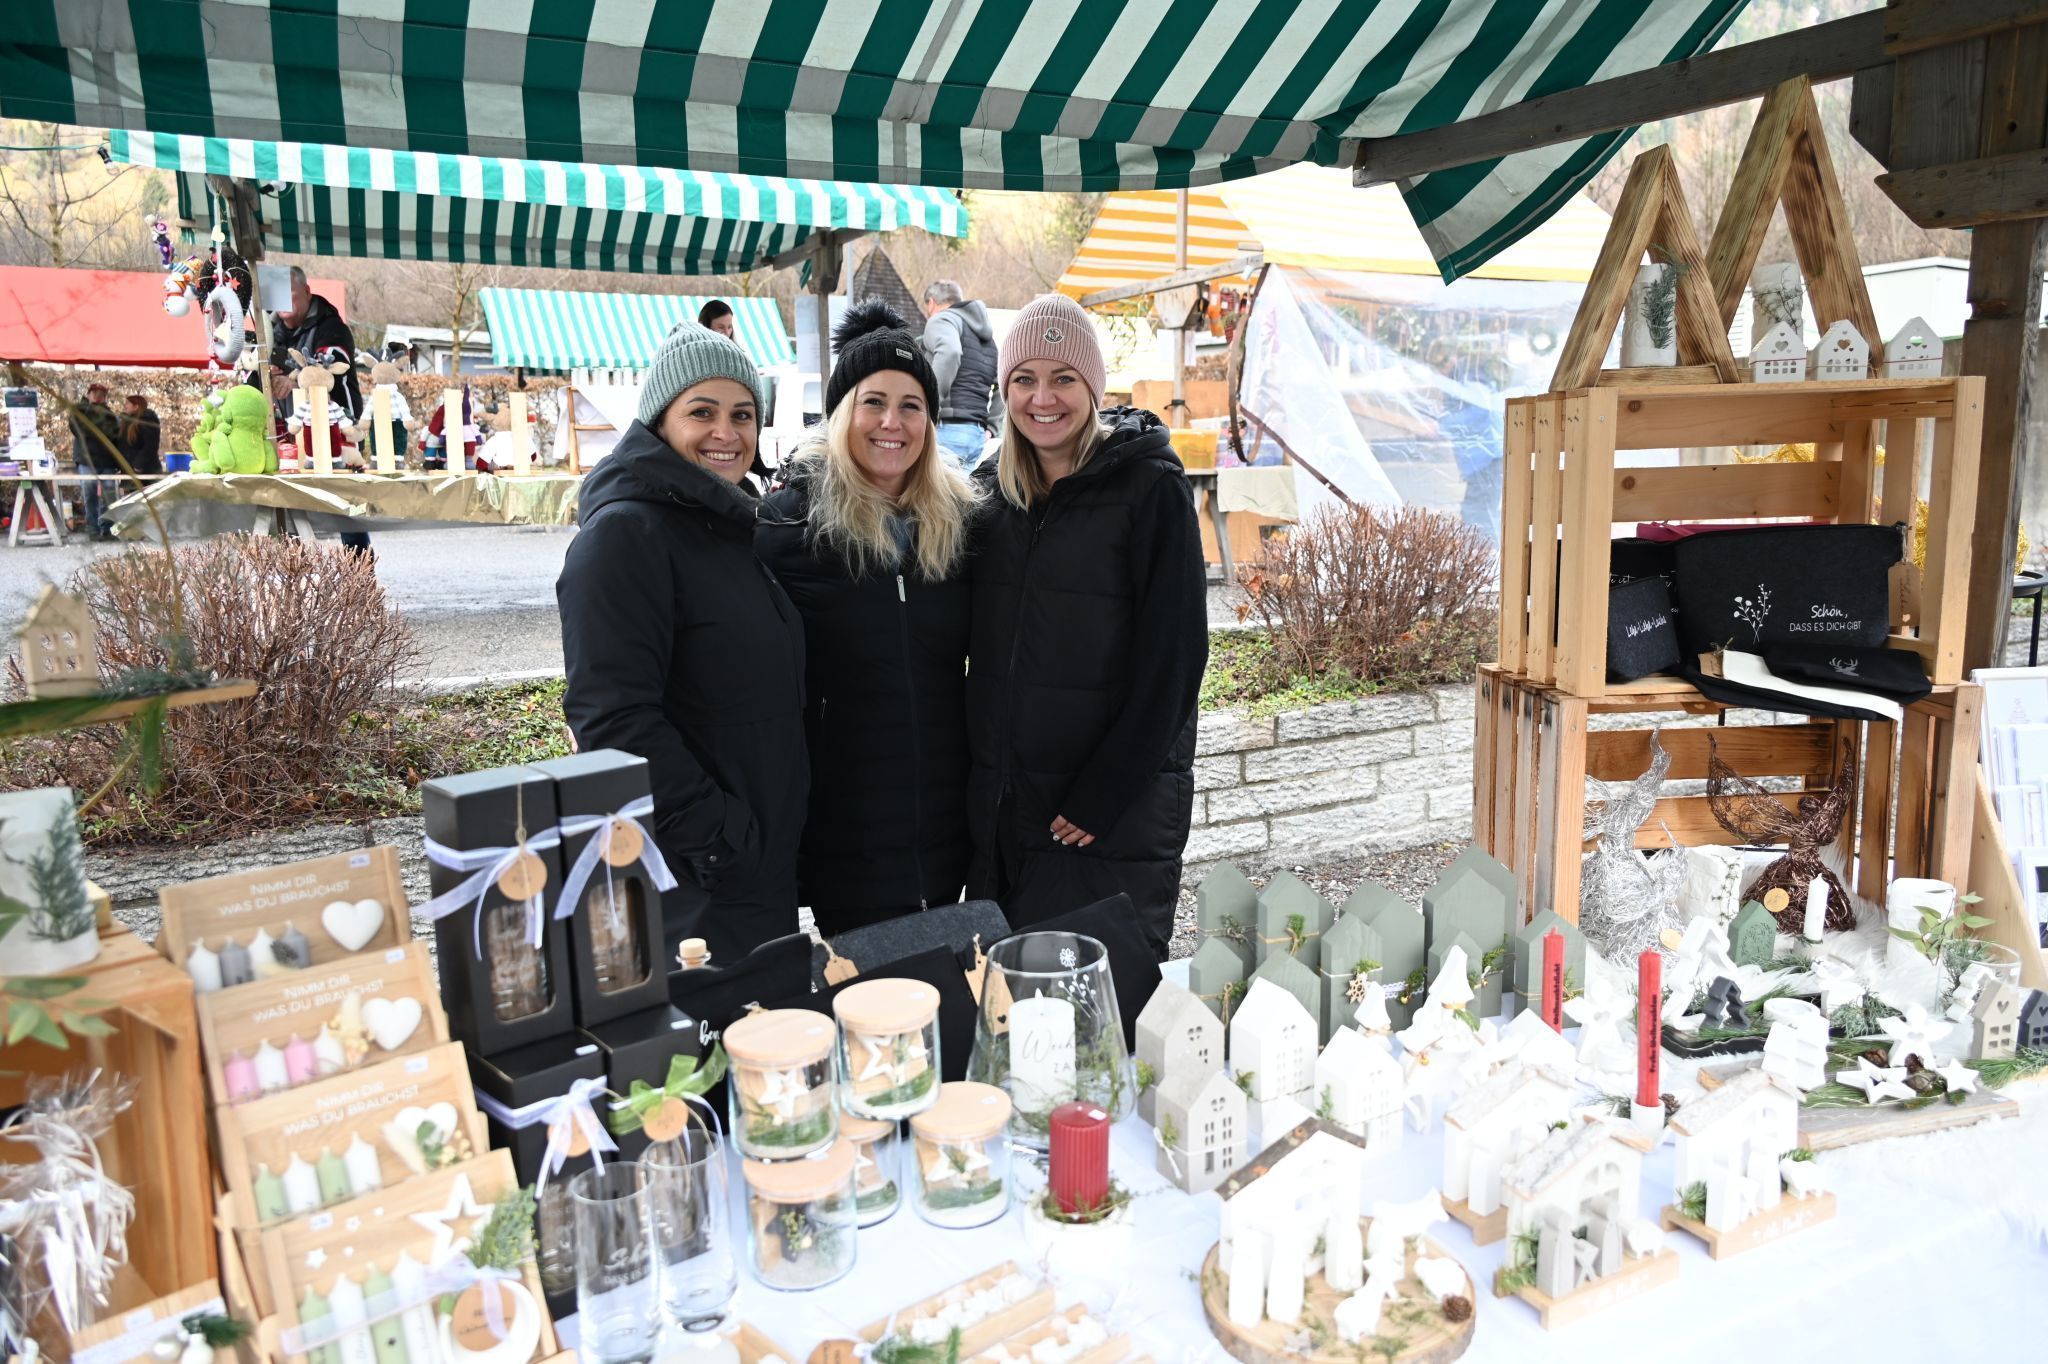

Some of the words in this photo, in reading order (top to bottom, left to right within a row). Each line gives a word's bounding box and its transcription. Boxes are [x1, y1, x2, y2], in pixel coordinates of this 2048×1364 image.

[1810, 603, 1848, 619] Schön,
[1789, 622, 1812, 632] DASS
[1813, 622, 1824, 632] ES
[1826, 621, 1846, 631] DICH
[1847, 620, 1862, 631] GIBT
[251, 880, 292, 896] NIMM
[294, 872, 318, 889] DIR
[218, 900, 253, 917] WAS
[255, 895, 278, 910] DU
[280, 879, 351, 906] BRAUCHST
[284, 980, 326, 999] NIMM
[328, 973, 352, 989] DIR
[254, 1003, 289, 1023] WAS
[290, 998, 312, 1014] DU
[284, 1115, 321, 1137] WAS
[321, 1106, 345, 1125] DU
[347, 1083, 420, 1116] BRAUCHST
[315, 1090, 360, 1110] NIMM
